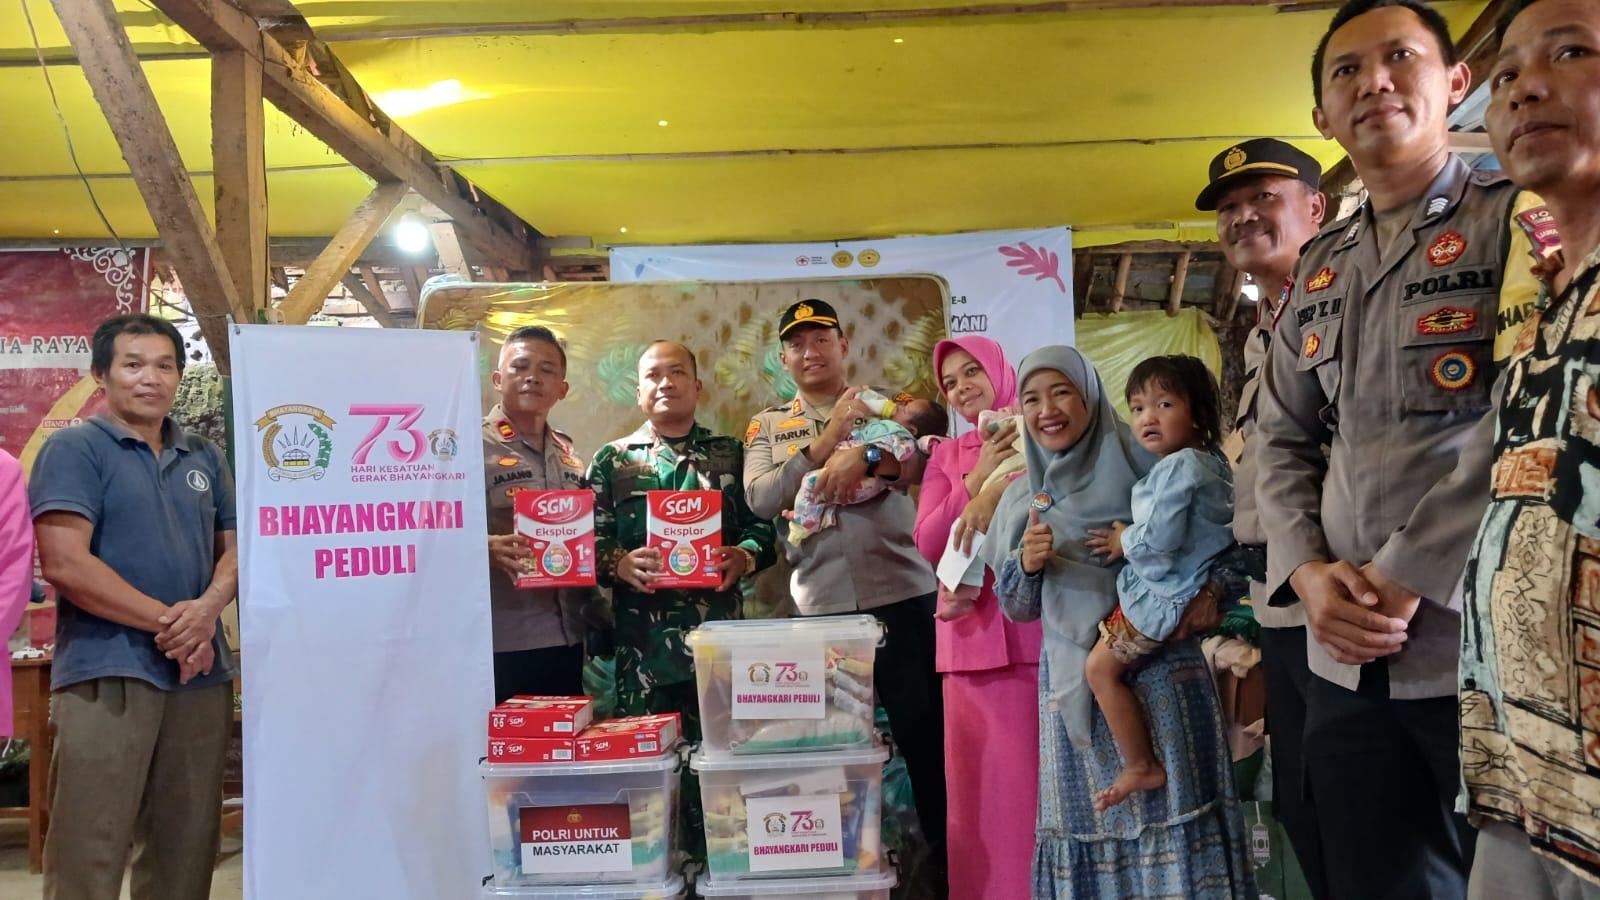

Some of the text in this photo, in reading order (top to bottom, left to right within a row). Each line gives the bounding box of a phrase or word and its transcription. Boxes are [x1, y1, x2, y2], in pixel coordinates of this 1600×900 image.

[1403, 269, 1493, 301] POLRI
[951, 295, 967, 304] E-8
[951, 314, 987, 332] MANI
[0, 338, 90, 354] IA RAYA
[348, 404, 428, 465] 73
[774, 428, 811, 442] FARUK
[351, 464, 435, 474] HARI KESATUAN
[351, 472, 465, 483] GERAK BHAYANGKARI
[537, 496, 574, 517] SGM
[665, 497, 702, 516] SGM
[259, 500, 464, 537] BHAYANGKARI
[535, 527, 578, 537] Eksplor
[663, 526, 705, 536] Eksplor
[575, 543, 592, 560] 1+
[315, 544, 416, 579] PEDULI
[775, 662, 798, 682] 73
[736, 694, 821, 704] BHAYANGKARI PEDULI
[509, 717, 524, 725] SGM
[508, 745, 523, 753] SGM
[595, 742, 609, 750] SGM
[790, 810, 814, 832] 73
[532, 827, 619, 840] POLRI UNTUK
[533, 843, 620, 856] MASYARAKAT
[753, 842, 838, 856] BHAYANGKARI PEDULI
